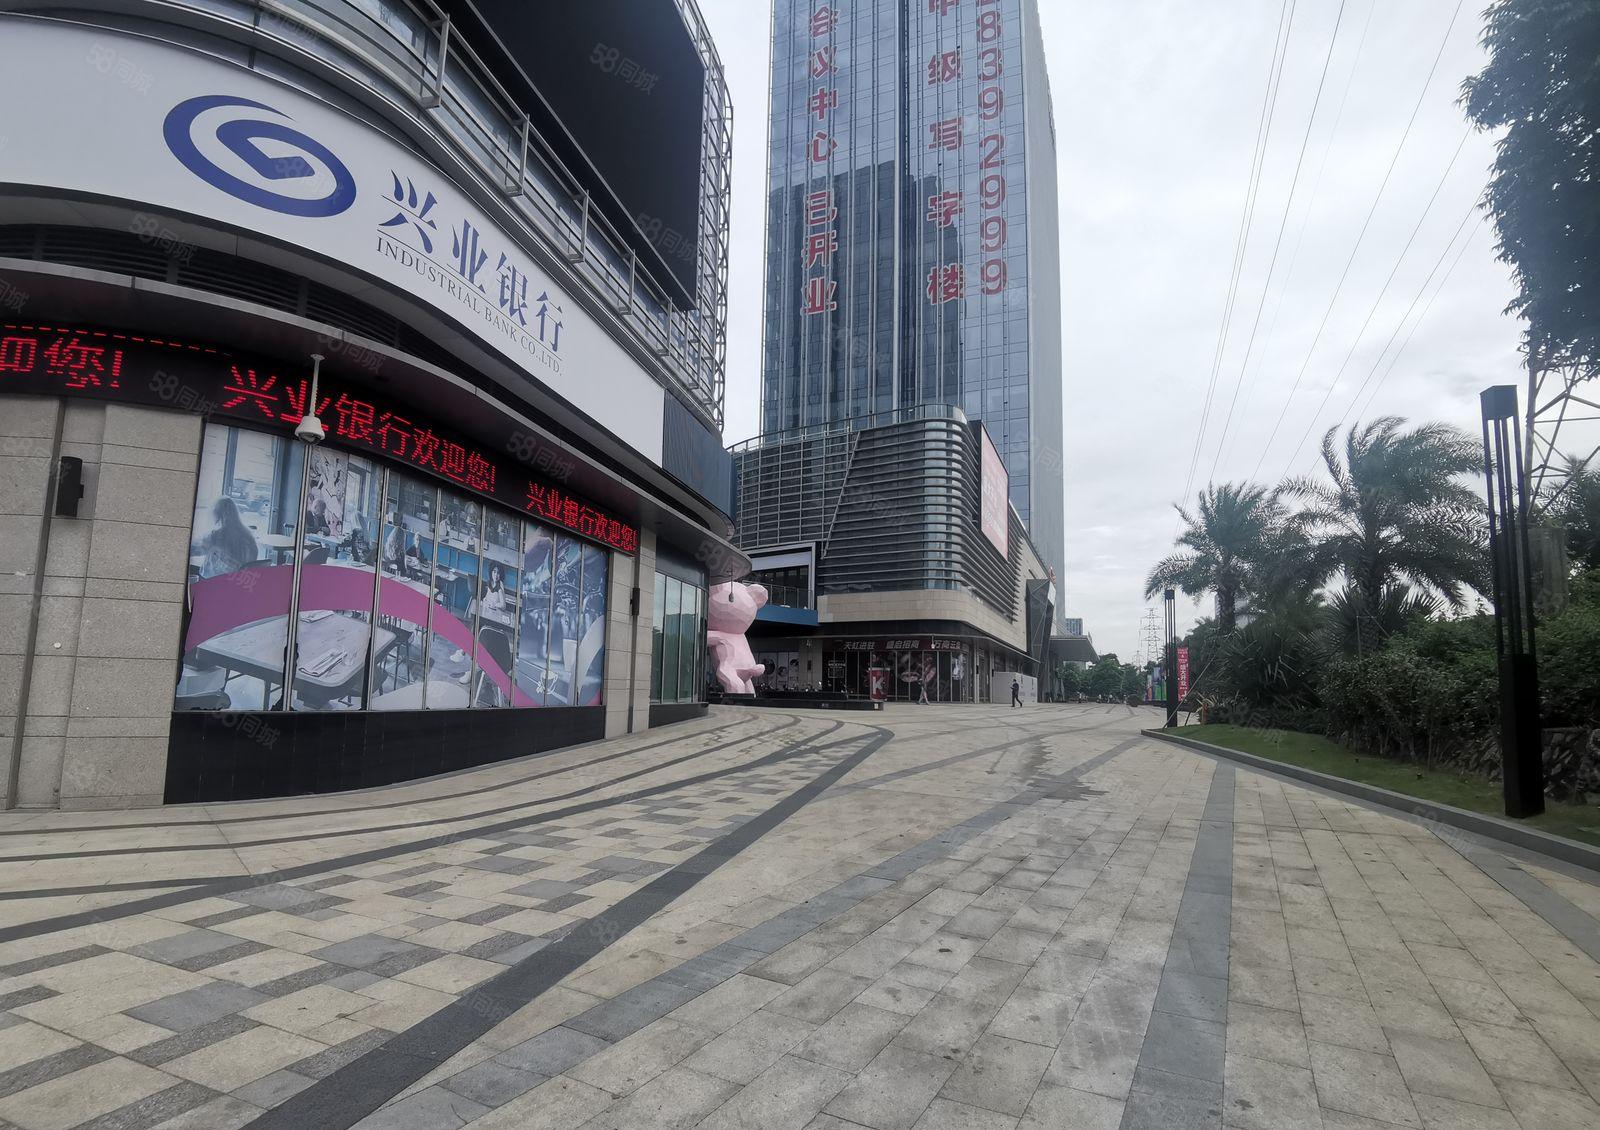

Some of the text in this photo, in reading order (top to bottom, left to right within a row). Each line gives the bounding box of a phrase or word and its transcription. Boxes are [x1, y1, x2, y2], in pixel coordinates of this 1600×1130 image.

[807, 6, 839, 163] 会议中心
[376, 236, 481, 316] INDUSTRIAL
[484, 305, 518, 343] BANK
[378, 169, 564, 352] 兴业银行
[222, 365, 495, 493] 兴业银行欢迎您!
[525, 480, 638, 551] 兴业银行欢迎您!
